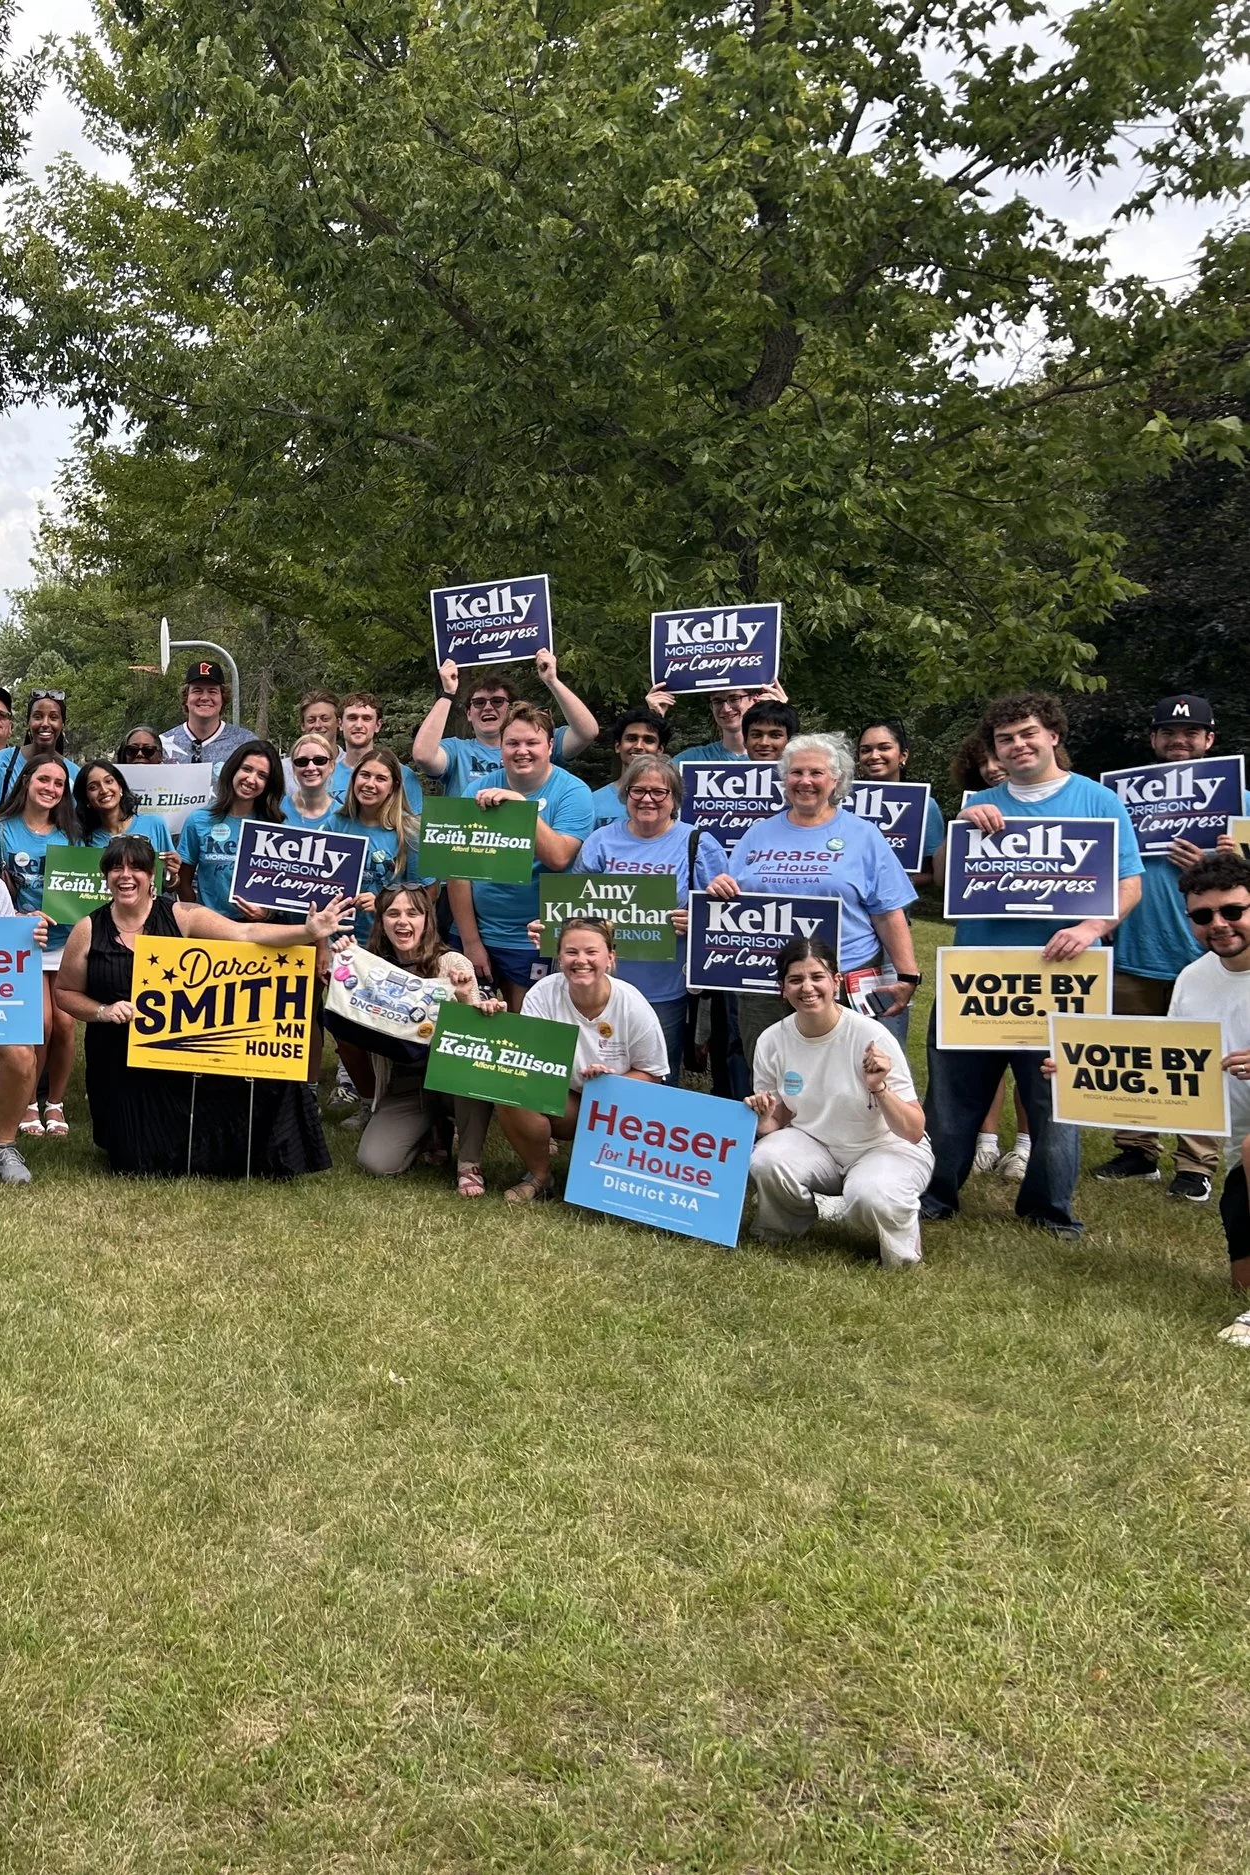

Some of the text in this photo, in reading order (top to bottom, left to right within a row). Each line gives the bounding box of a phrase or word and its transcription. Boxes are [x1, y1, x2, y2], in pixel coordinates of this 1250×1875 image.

[444, 585, 536, 623] Kelly
[446, 615, 512, 632] MORRISON
[665, 612, 765, 651] Kelly
[448, 626, 539, 653] for Congress
[665, 642, 735, 657] MORRISON
[664, 654, 763, 678] for Congress
[1172, 703, 1190, 717] M
[693, 768, 786, 811] Kelly
[1114, 766, 1226, 810] Kelly
[156, 793, 206, 806] Ellison
[693, 800, 768, 811] MORRISON
[1127, 801, 1192, 816] ORRISON
[694, 815, 718, 829] for
[1138, 814, 1226, 838] Congress
[423, 829, 531, 849] Keith Ellison
[964, 824, 1098, 873] Kelly
[251, 829, 351, 878] Kelly
[471, 846, 485, 854] Your
[485, 847, 497, 855] Life
[756, 849, 844, 863] Heaser
[250, 857, 320, 877] MORRISON
[758, 863, 829, 872] for House
[964, 860, 1059, 873] MORRISON
[47, 876, 95, 893] Keith
[245, 871, 345, 898] for Congress
[761, 876, 800, 884] District
[962, 872, 1097, 900] for Congress
[578, 879, 637, 905] Amy
[614, 929, 662, 941] ERNOR
[705, 934, 789, 949] MORRISON
[179, 947, 272, 989] Darci
[703, 950, 733, 970] for
[950, 973, 1099, 995] VOTE BY
[134, 975, 309, 1035] SMITH
[960, 995, 1085, 1017] AUG. 11
[380, 1009, 409, 1024] 2024
[276, 1022, 305, 1039] MN
[442, 1030, 487, 1042] Attorney General
[245, 1040, 303, 1059] HOUSE
[436, 1037, 493, 1062] Keith
[495, 1048, 567, 1077] Ellison
[1061, 1042, 1212, 1072] VOTE BY
[472, 1060, 528, 1077] Afford Your Life
[1072, 1067, 1200, 1097] AUG. 11
[587, 1100, 737, 1163] Heaser
[596, 1143, 712, 1187] for House
[603, 1175, 699, 1212] District 34A
